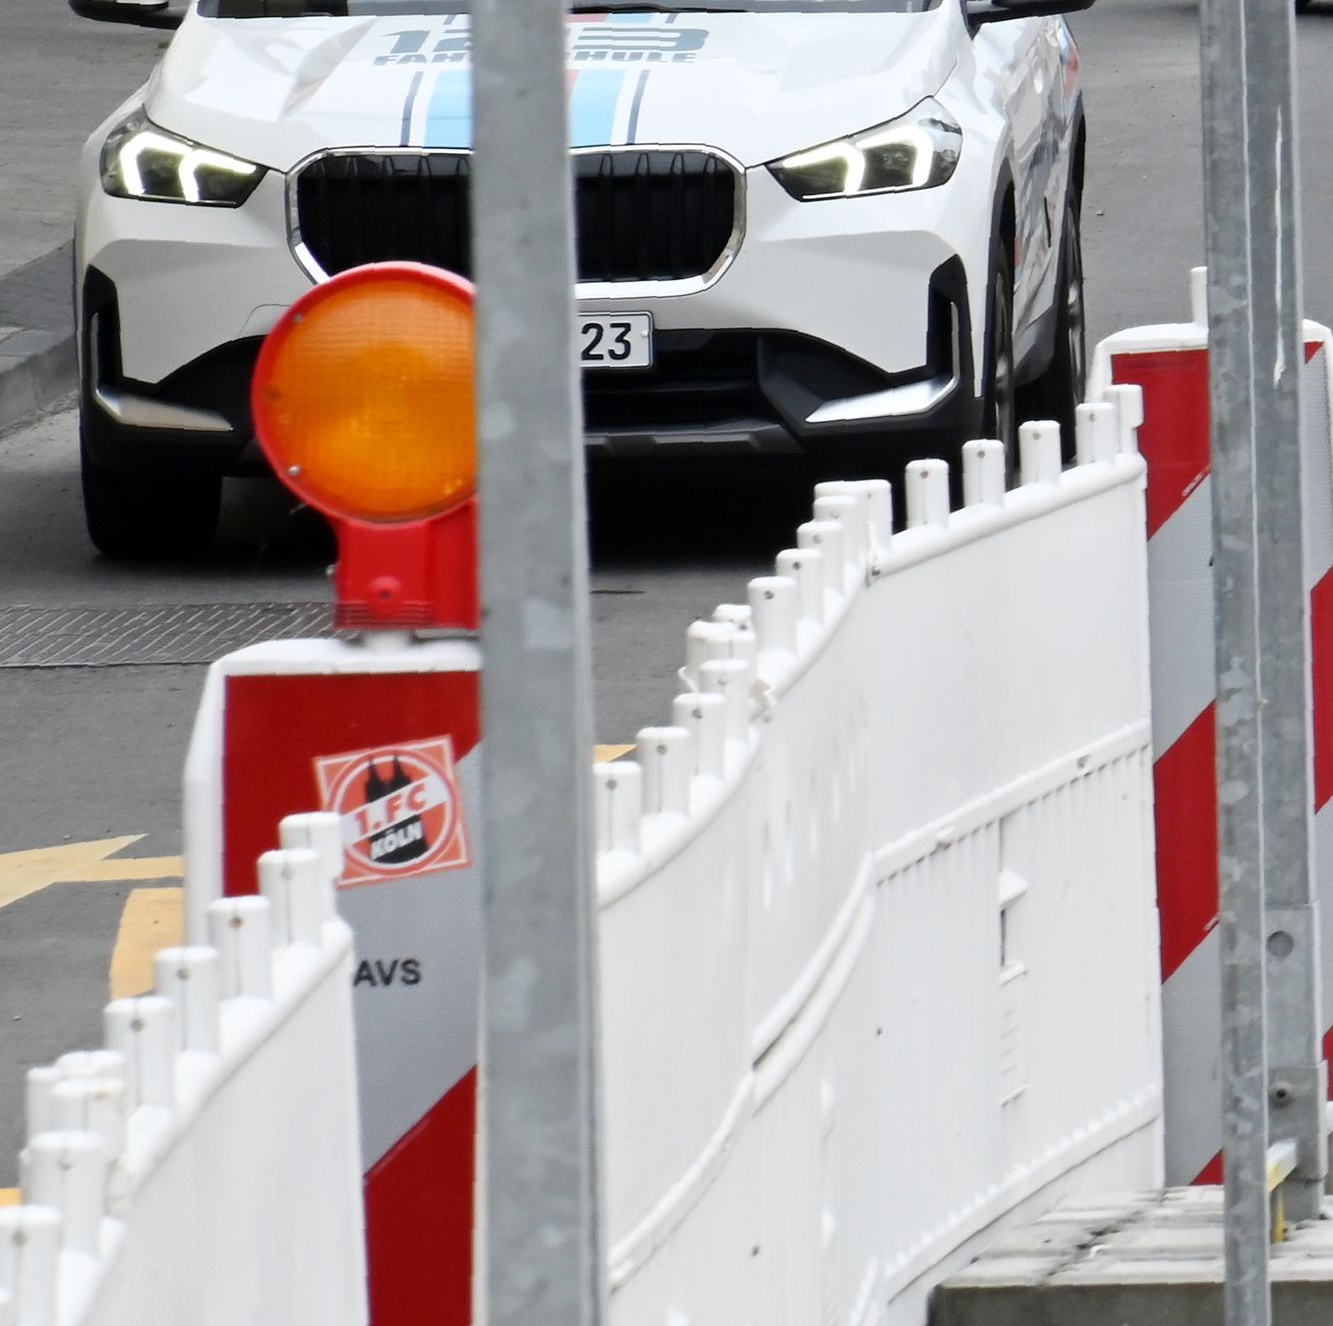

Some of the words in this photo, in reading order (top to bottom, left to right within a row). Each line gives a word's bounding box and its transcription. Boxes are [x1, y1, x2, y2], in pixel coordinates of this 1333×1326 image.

[373, 50, 697, 67] FAHHULE
[581, 322, 632, 361] 23
[371, 820, 424, 861] KÖLN
[353, 958, 422, 986] AVS
